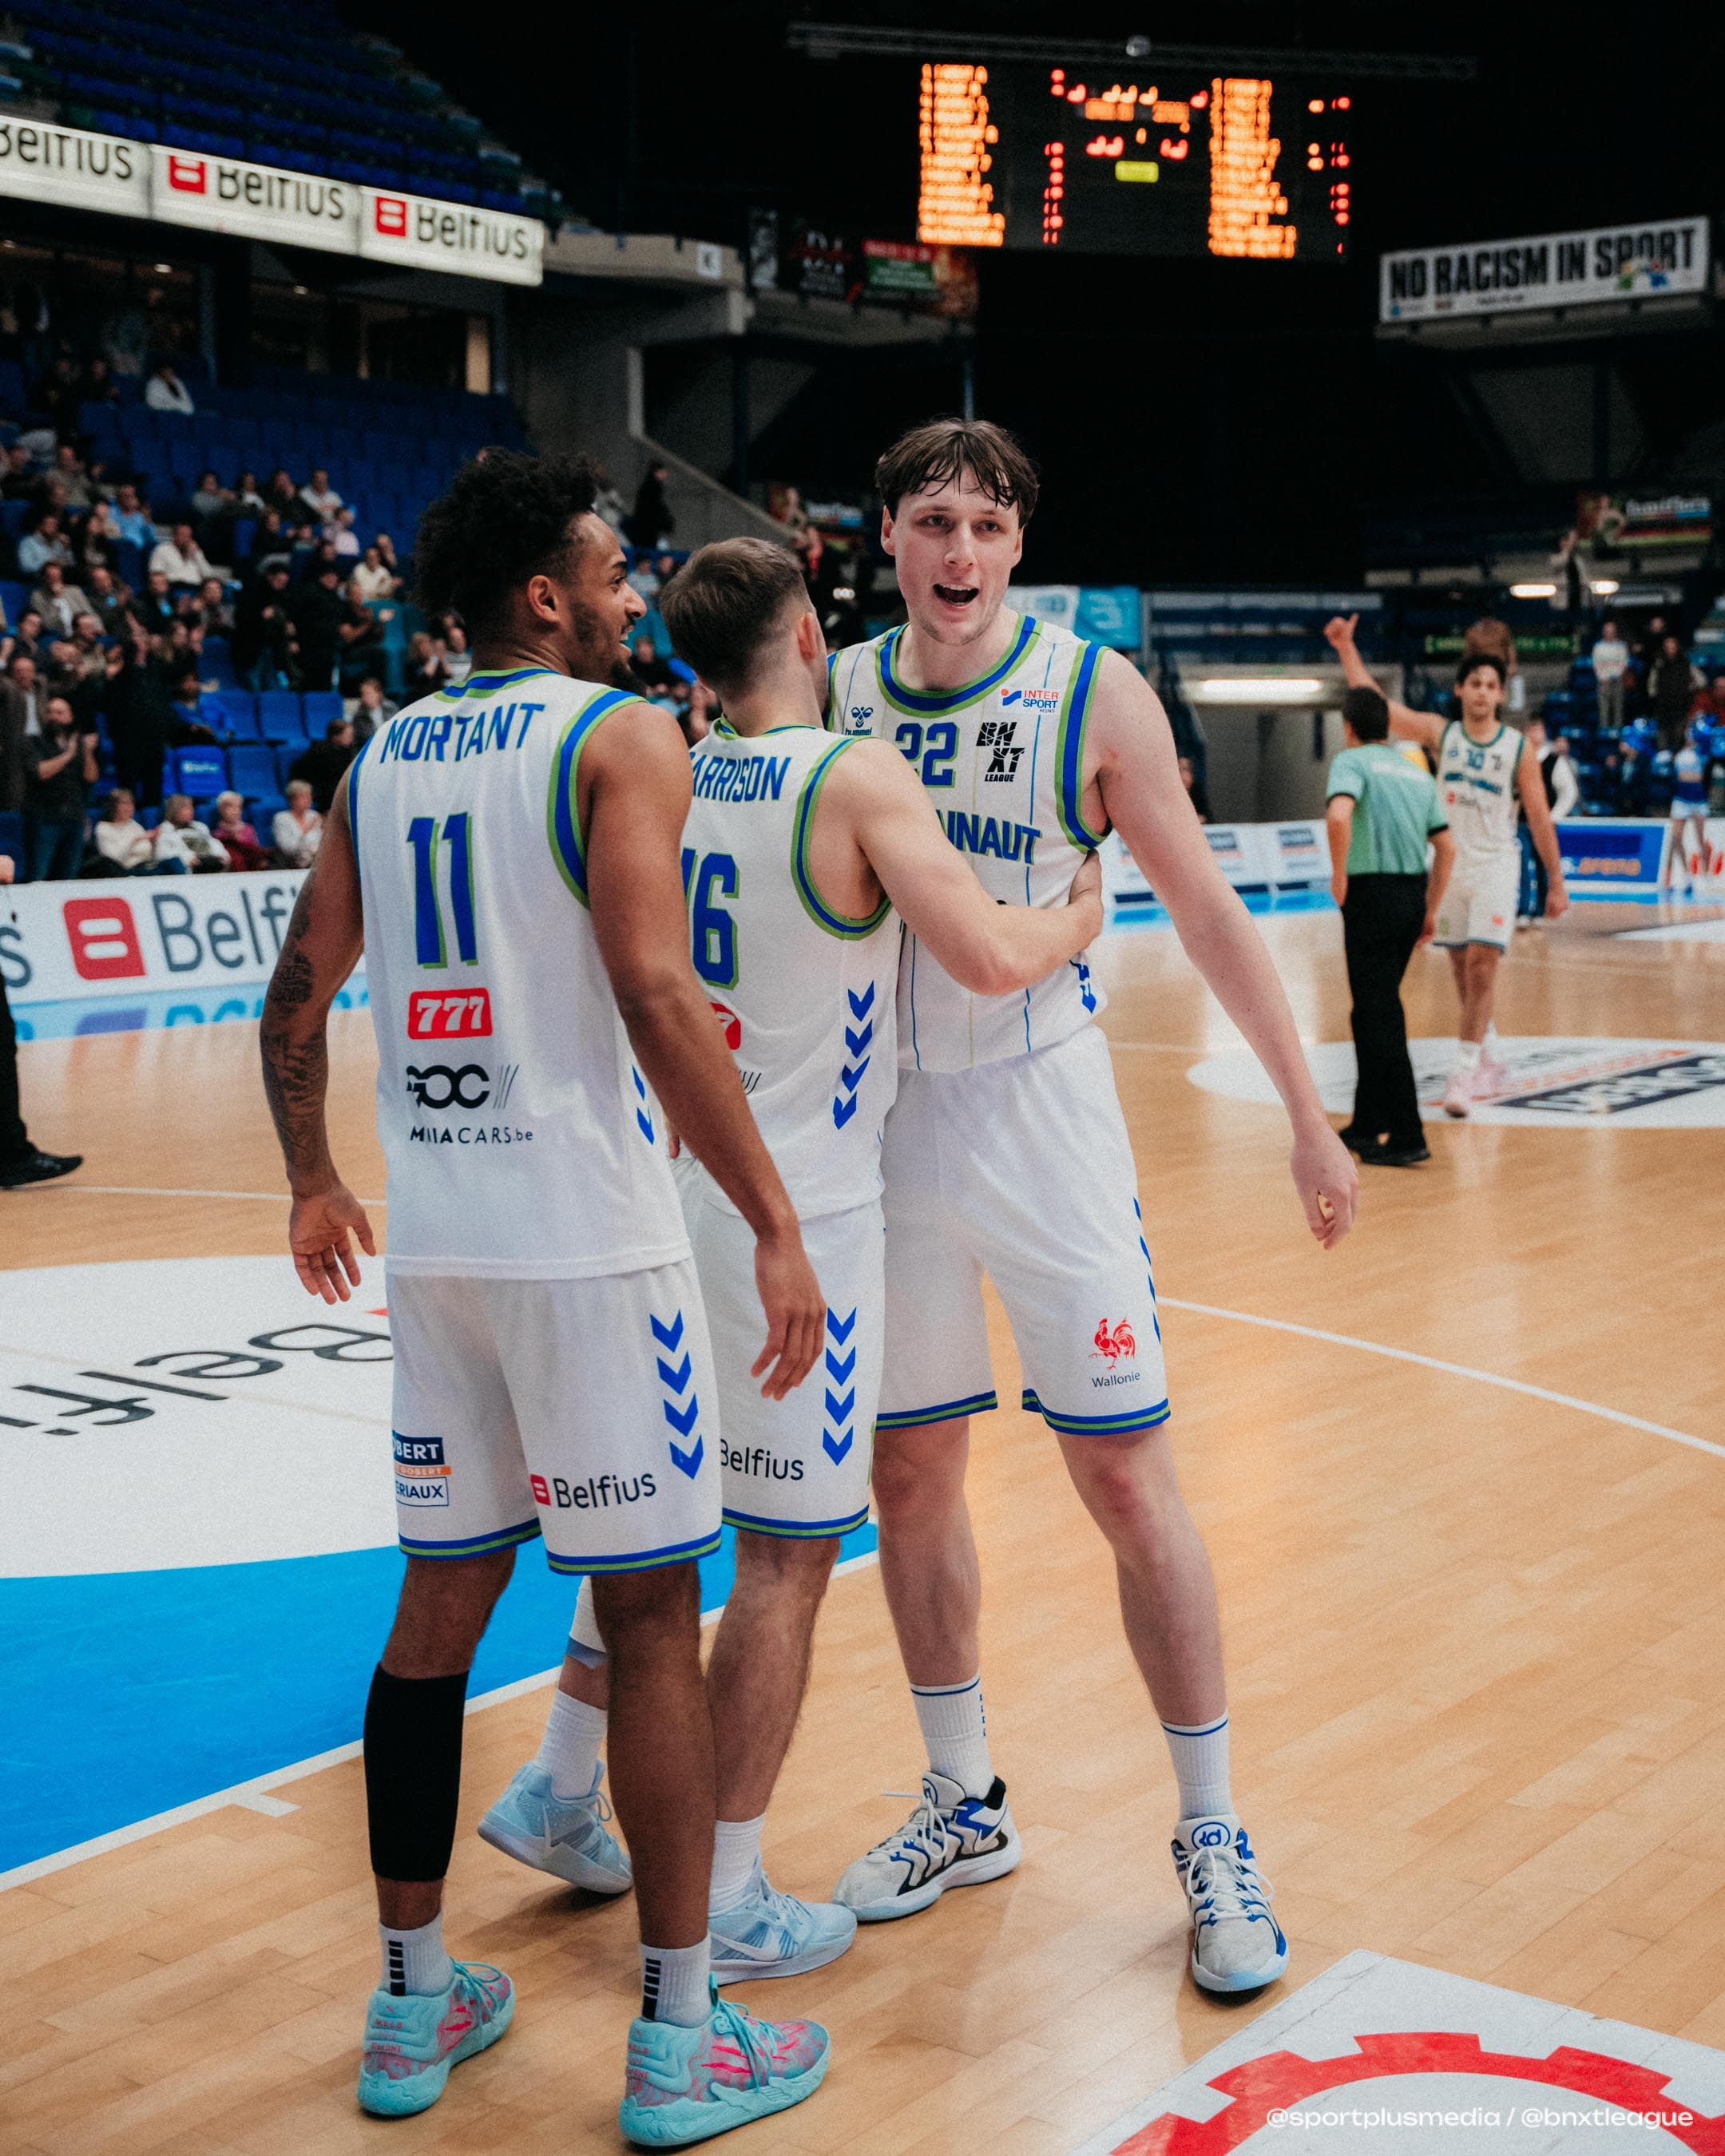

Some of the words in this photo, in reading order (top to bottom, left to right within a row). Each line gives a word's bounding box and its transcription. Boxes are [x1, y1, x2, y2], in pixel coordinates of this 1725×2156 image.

[1390, 257, 1428, 298] NO
[1436, 243, 1549, 295] RACISM
[1556, 240, 1588, 282] IN
[1594, 228, 1695, 279] SPORT
[1023, 699, 1058, 709] SPORT
[1024, 690, 1059, 700] INTER
[379, 703, 546, 763] MORTANT
[845, 727, 873, 735] hummel
[895, 722, 959, 788] 22
[689, 751, 792, 803] ARRISON
[984, 774, 1015, 783] LEAGUE
[935, 809, 1043, 866] INAUT
[407, 812, 478, 969] 11
[152, 886, 297, 973] Belf
[417, 997, 485, 1032] 777
[1092, 1372, 1140, 1388] Wallonie
[392, 1440, 439, 1460] BERT
[720, 1438, 803, 1480] Belfius
[553, 1473, 656, 1508] Belfius
